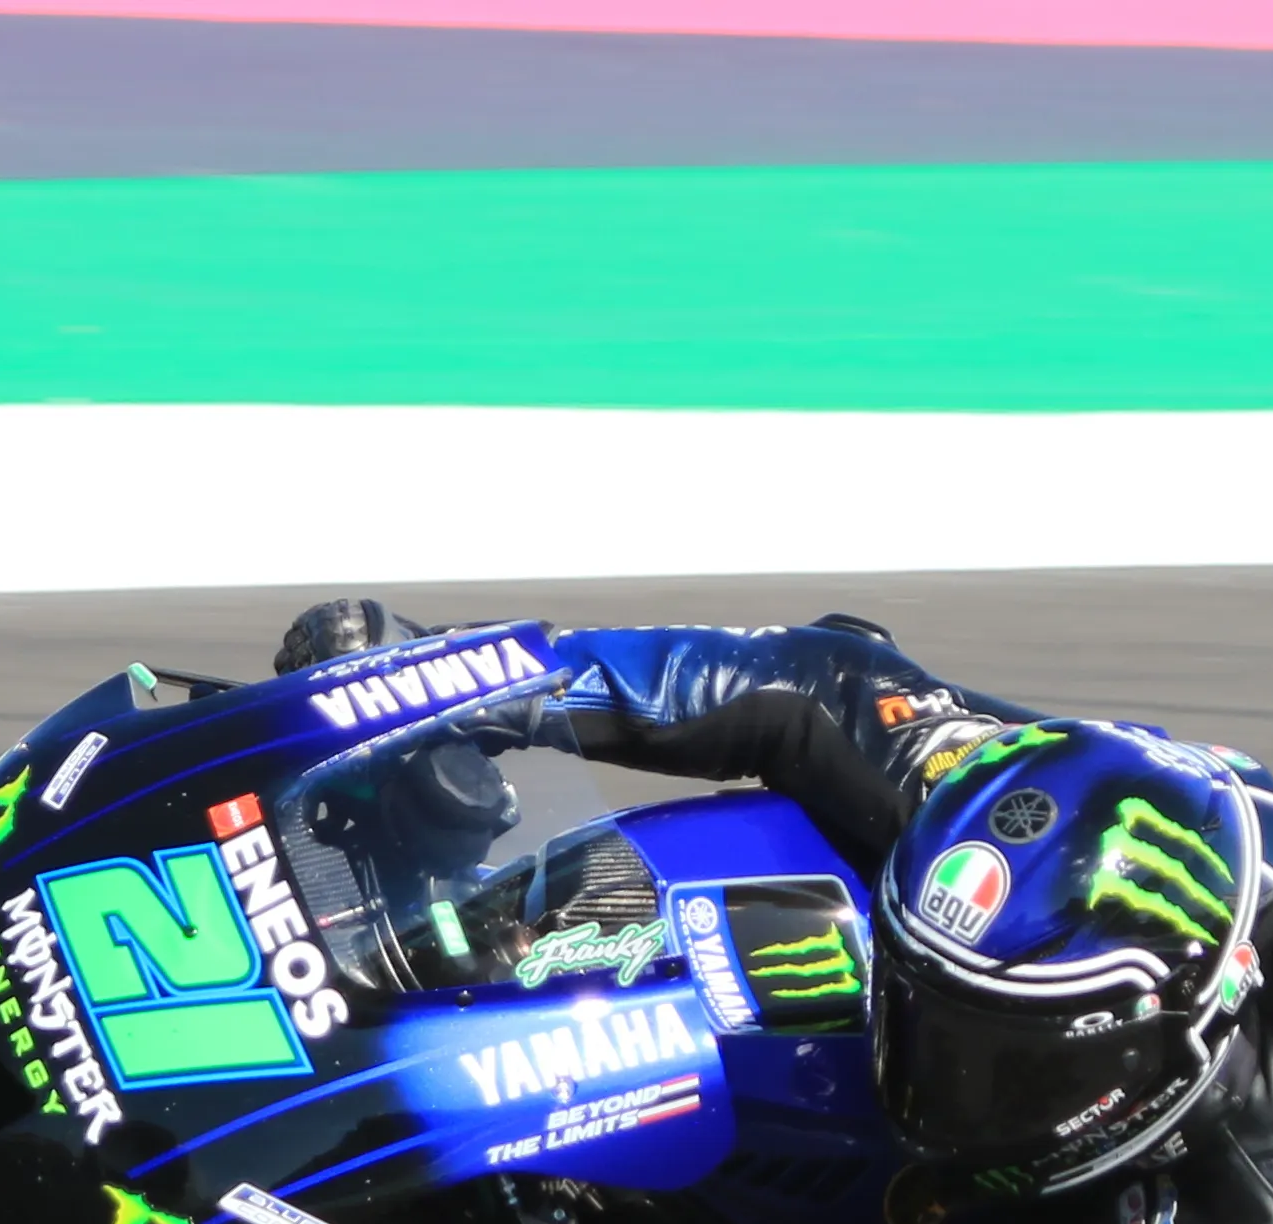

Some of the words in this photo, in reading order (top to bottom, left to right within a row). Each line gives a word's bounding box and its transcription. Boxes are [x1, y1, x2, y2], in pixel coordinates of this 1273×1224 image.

[310, 637, 547, 729] YAMAHA
[219, 824, 349, 1039] ENEOS
[927, 886, 984, 932] agv
[36, 841, 315, 1091] 21
[517, 917, 667, 987] Franky
[1, 888, 123, 1145] MONSTER
[459, 1002, 697, 1107] YAMAHA
[487, 1134, 542, 1165] THE
[546, 1109, 642, 1150] LIMITS
[547, 1085, 663, 1130] BEYOND
[1054, 1088, 1126, 1137] SECTOR
